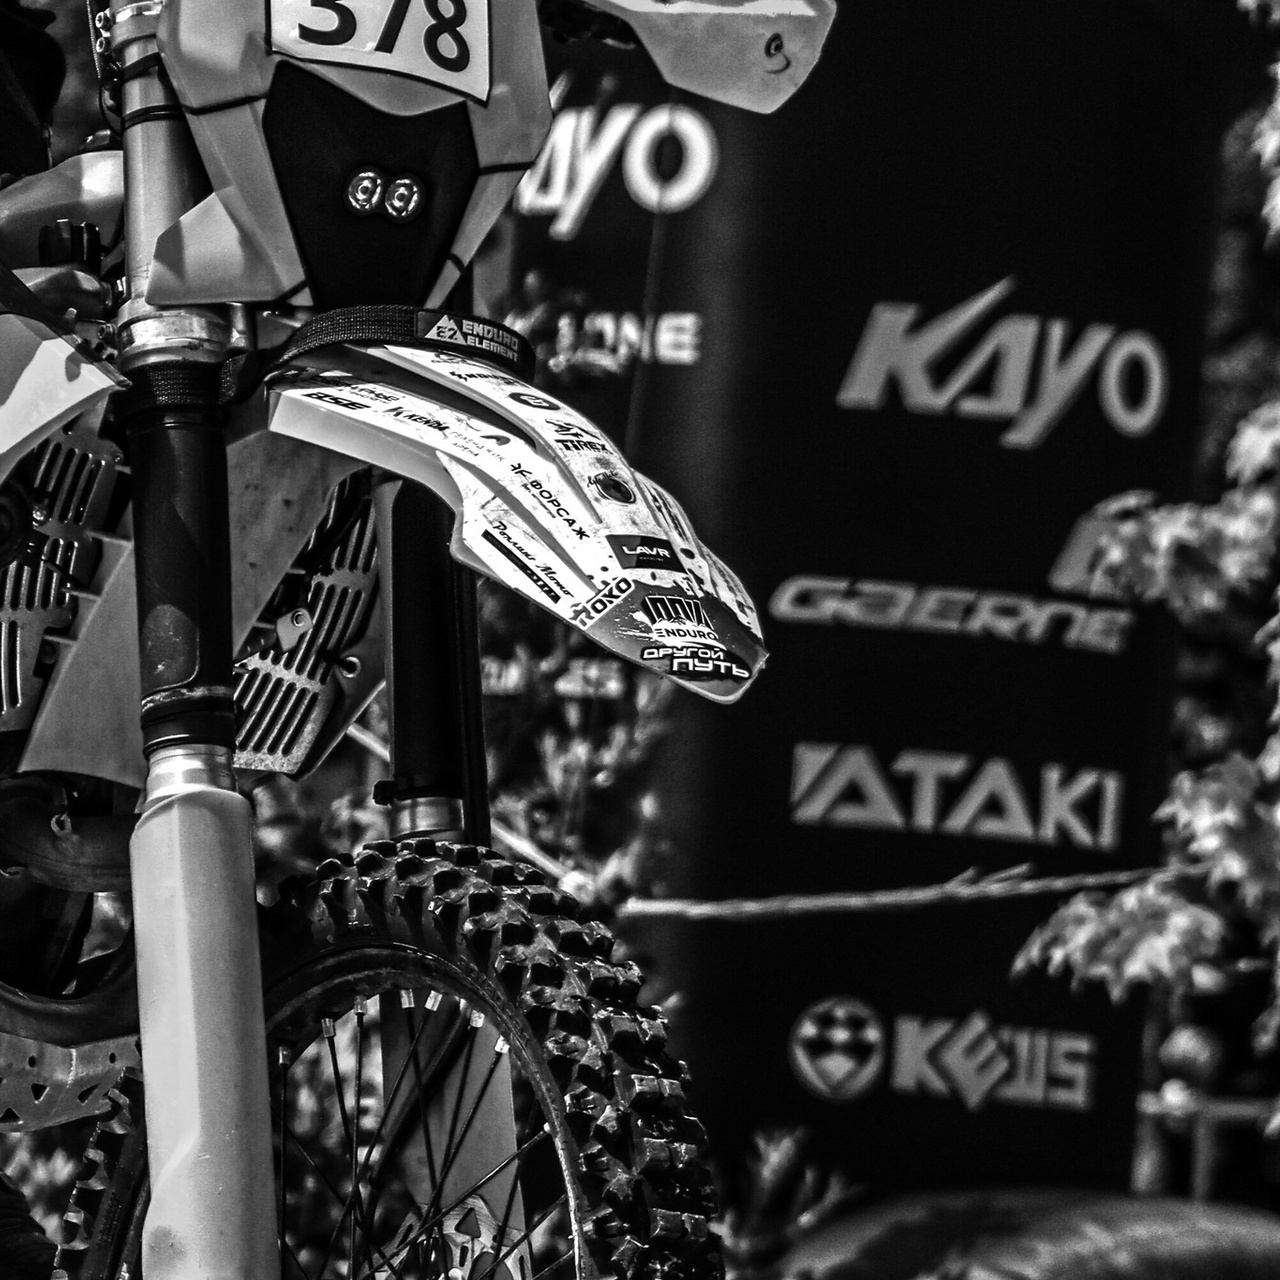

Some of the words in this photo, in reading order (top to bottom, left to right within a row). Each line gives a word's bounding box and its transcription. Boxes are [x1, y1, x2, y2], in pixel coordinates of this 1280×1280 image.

[512, 100, 721, 242] AYO
[462, 319, 520, 351] ENDURO
[466, 336, 519, 363] ELEMENT
[834, 275, 1167, 450] KAYO
[301, 391, 372, 410] BSE
[403, 413, 450, 432] KENDA
[530, 479, 591, 541] ФОРСАЖ
[621, 545, 671, 558] LAVR
[767, 573, 1136, 653] GAERNE
[654, 627, 718, 641] ENDURO
[642, 647, 724, 660] ДРУГОЙ
[672, 658, 750, 680] ПУТЬ
[789, 740, 1124, 852] ATAKI
